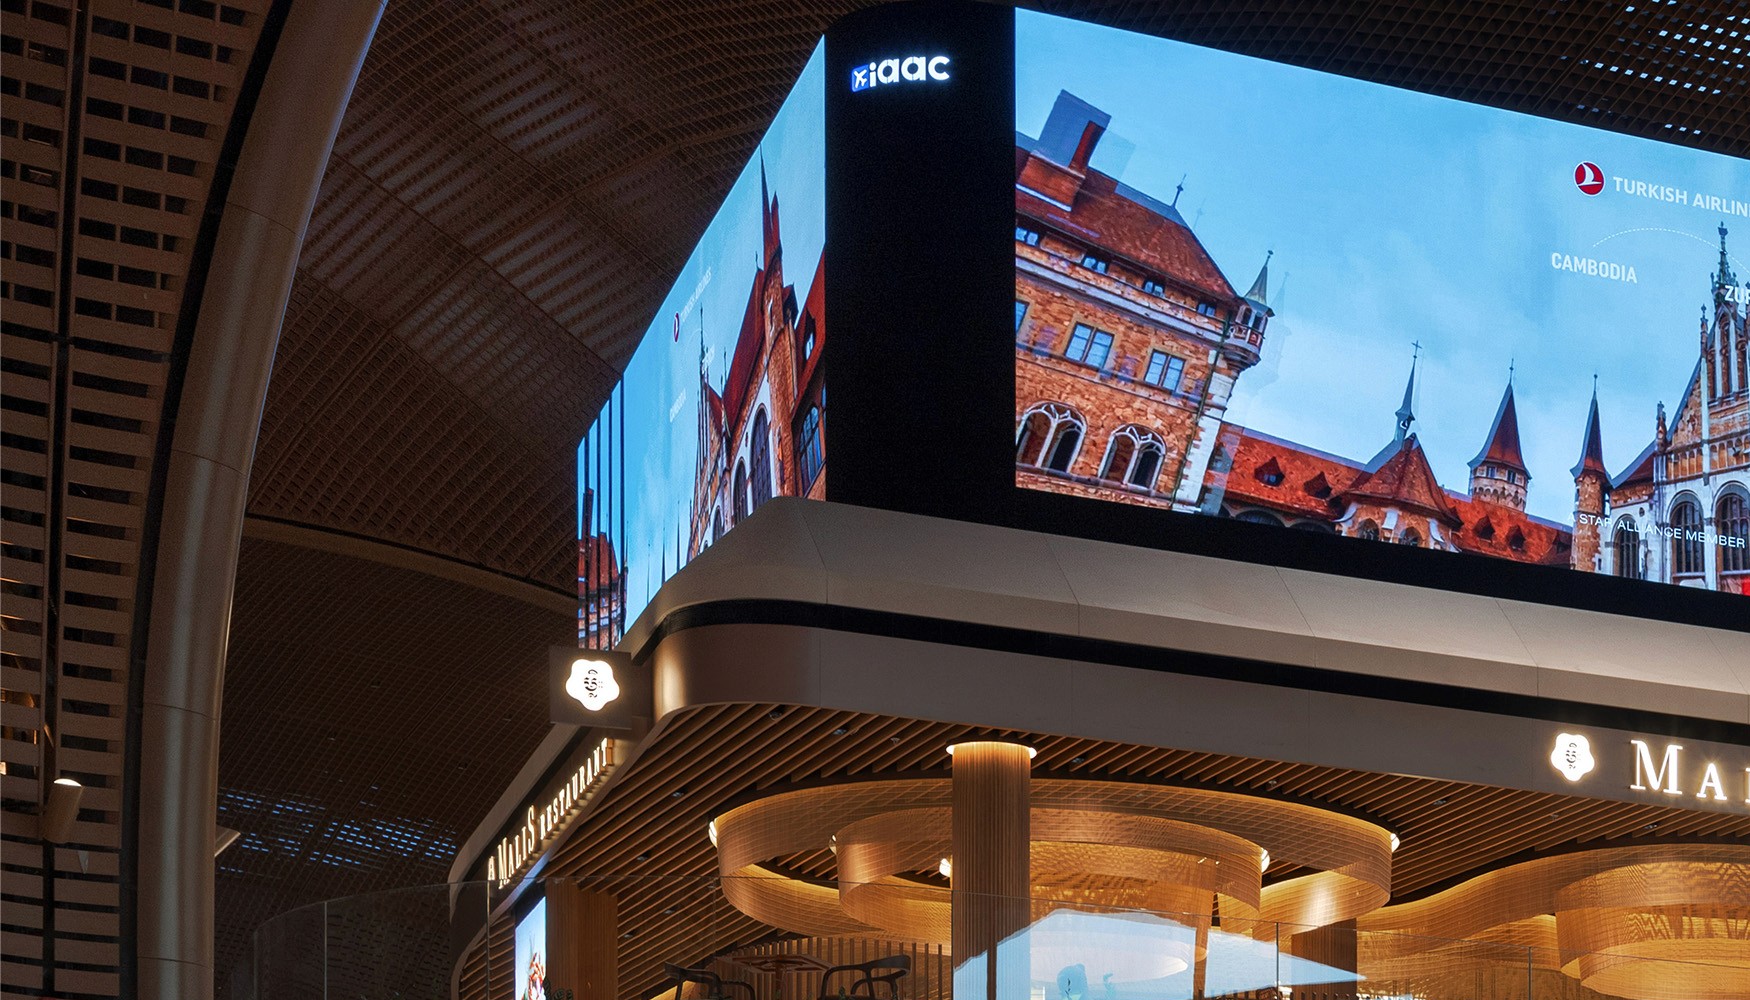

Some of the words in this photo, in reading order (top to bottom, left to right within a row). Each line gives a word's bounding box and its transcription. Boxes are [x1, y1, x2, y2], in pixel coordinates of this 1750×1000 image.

[869, 56, 950, 87] iaac
[1613, 176, 1688, 205] TURKISH
[1551, 252, 1638, 283] CAMBODIA
[1579, 513, 1612, 528] STAR
[1617, 519, 1682, 539] ALLIANCE
[1686, 530, 1746, 549] MEMBER
[540, 737, 608, 841] RESTAURANT
